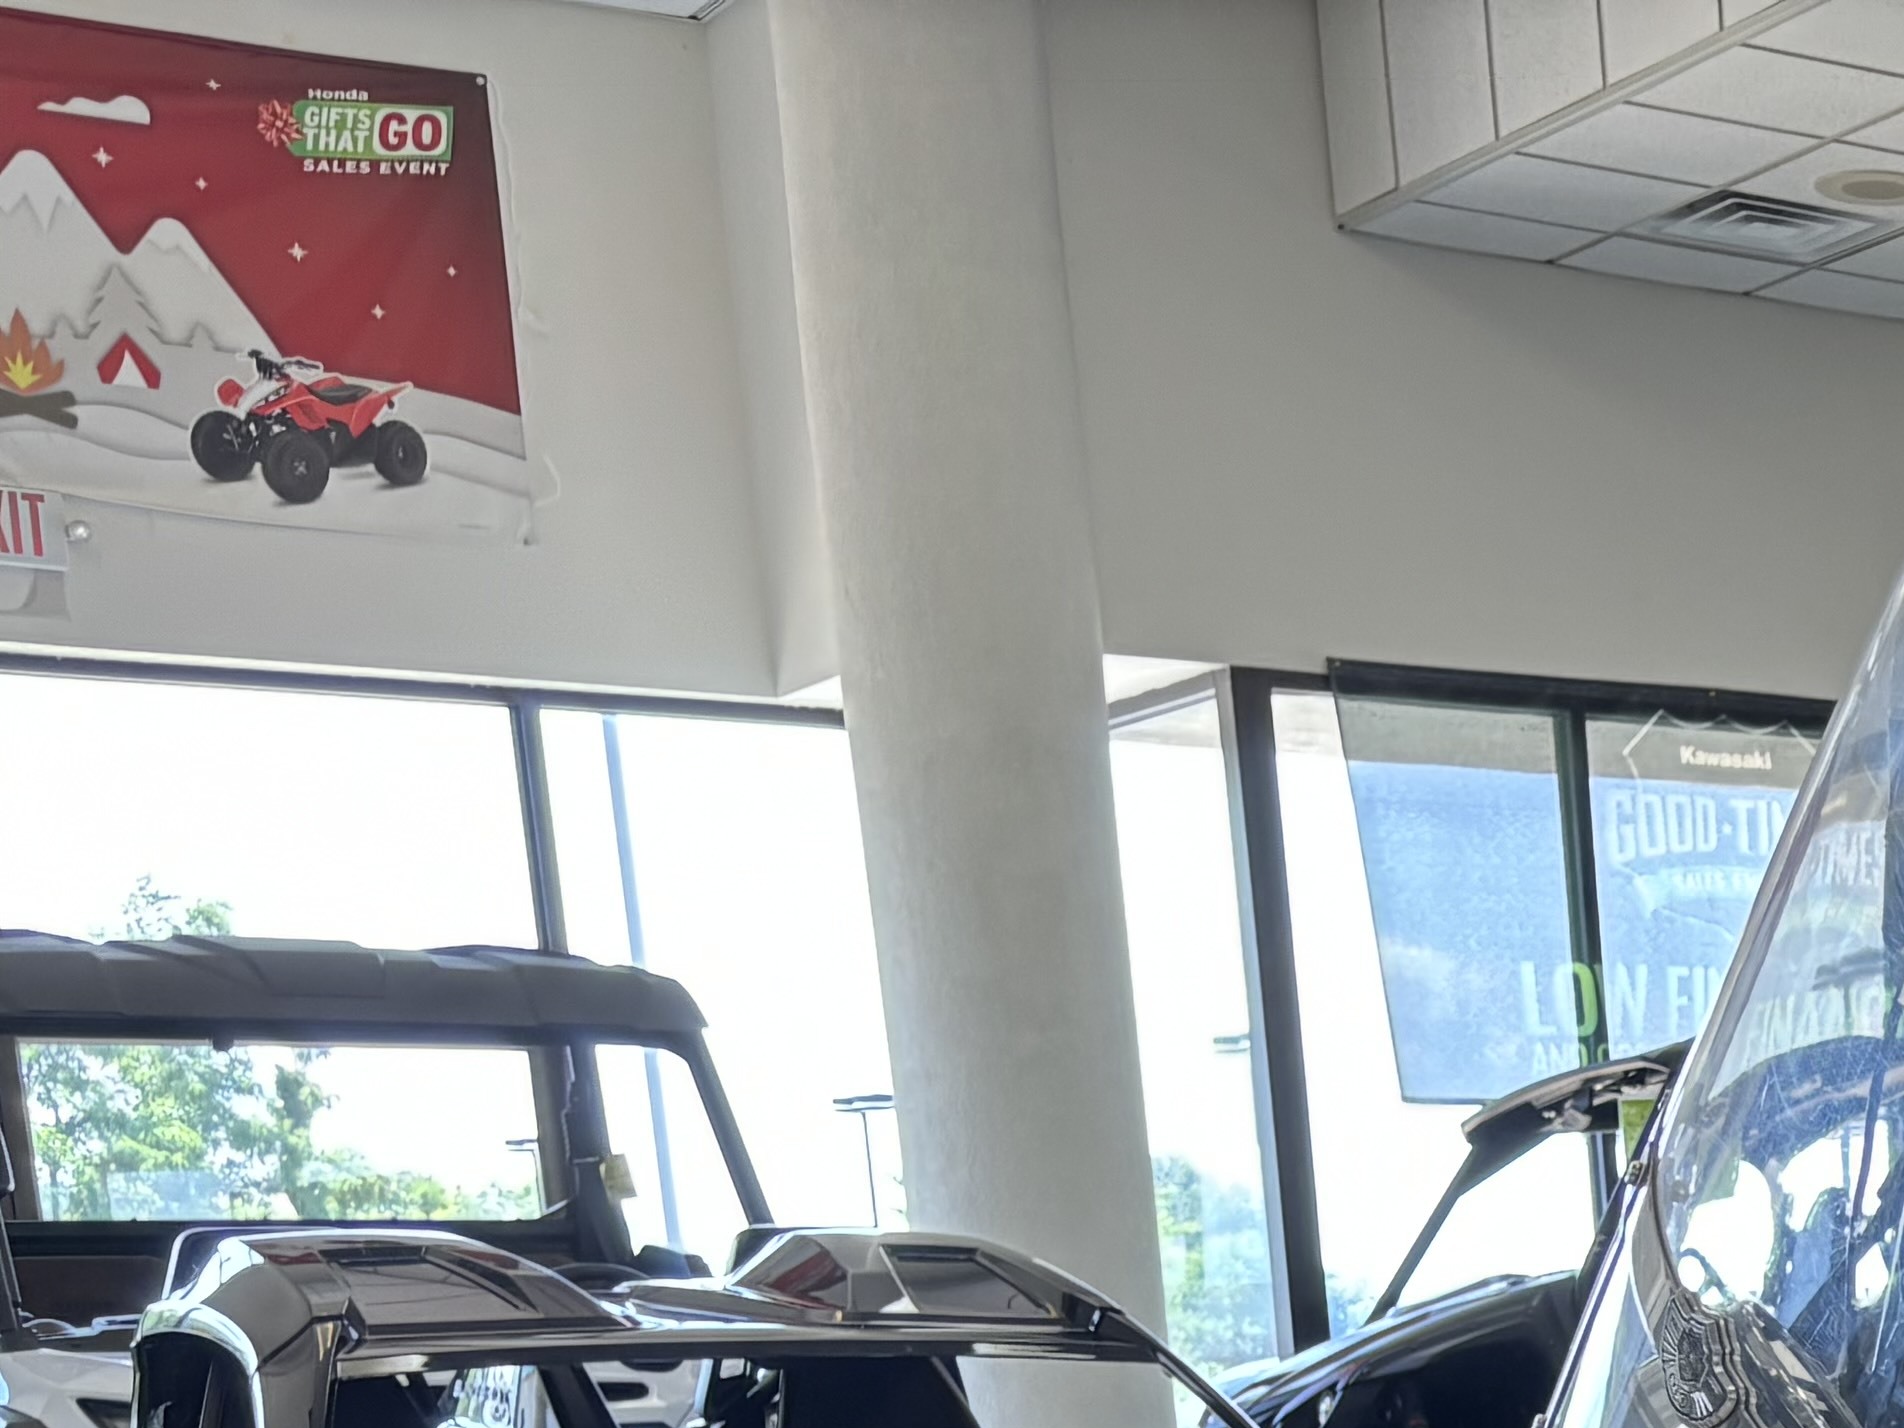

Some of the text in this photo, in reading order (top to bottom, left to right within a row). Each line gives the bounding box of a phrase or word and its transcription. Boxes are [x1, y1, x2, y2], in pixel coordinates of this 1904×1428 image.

[307, 88, 369, 101] Honda
[304, 106, 371, 129] GIFTS
[303, 128, 370, 153] THAT
[378, 112, 443, 152] GO
[303, 159, 450, 176] SALES EVENT
[1679, 745, 1772, 770] Kawasaki
[1605, 789, 1719, 863] GOOD
